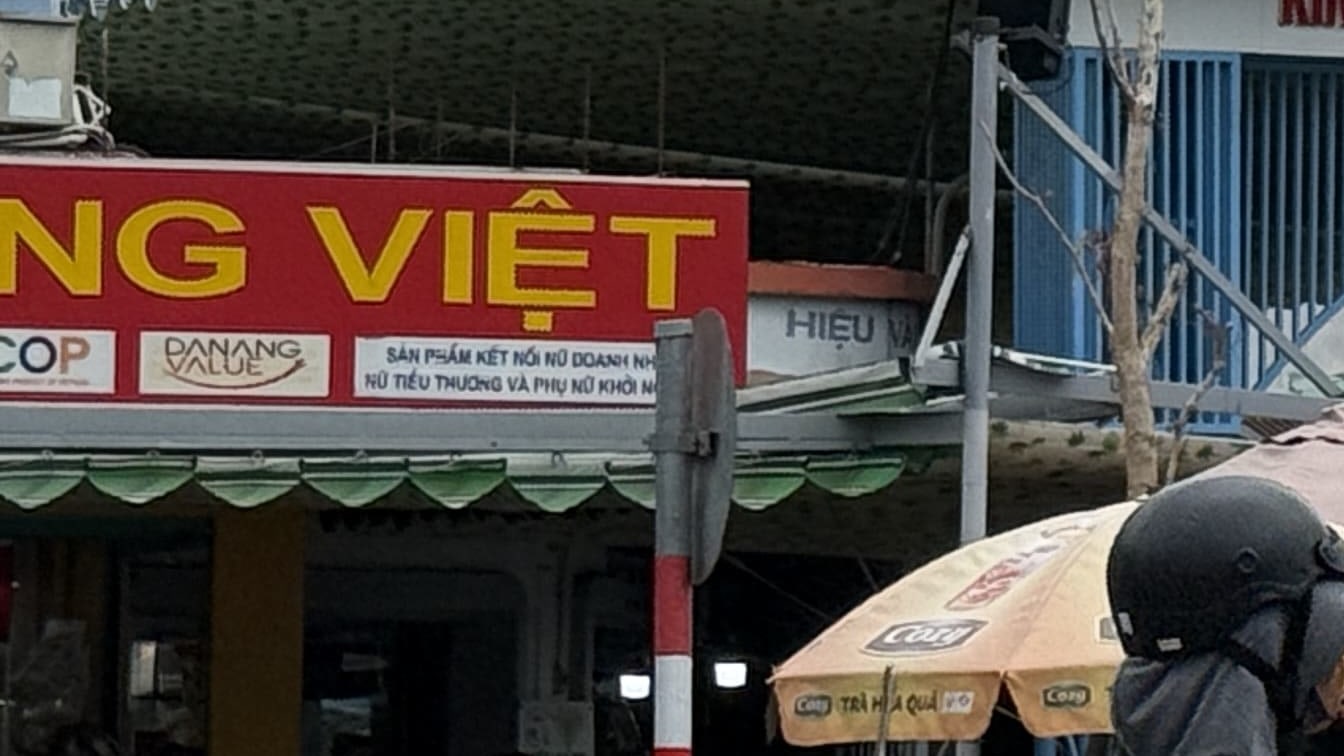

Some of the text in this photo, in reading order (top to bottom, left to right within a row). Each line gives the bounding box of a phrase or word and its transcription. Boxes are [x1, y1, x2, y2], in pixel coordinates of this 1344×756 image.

[0, 188, 715, 332] NG VIỆT
[785, 308, 875, 351] HIỆU
[165, 337, 303, 359] DANANG
[167, 356, 263, 376] VALUE
[572, 351, 628, 369] DOANH
[507, 372, 530, 393] VÀ
[883, 623, 971, 646] Cozy
[872, 694, 902, 713] HA
